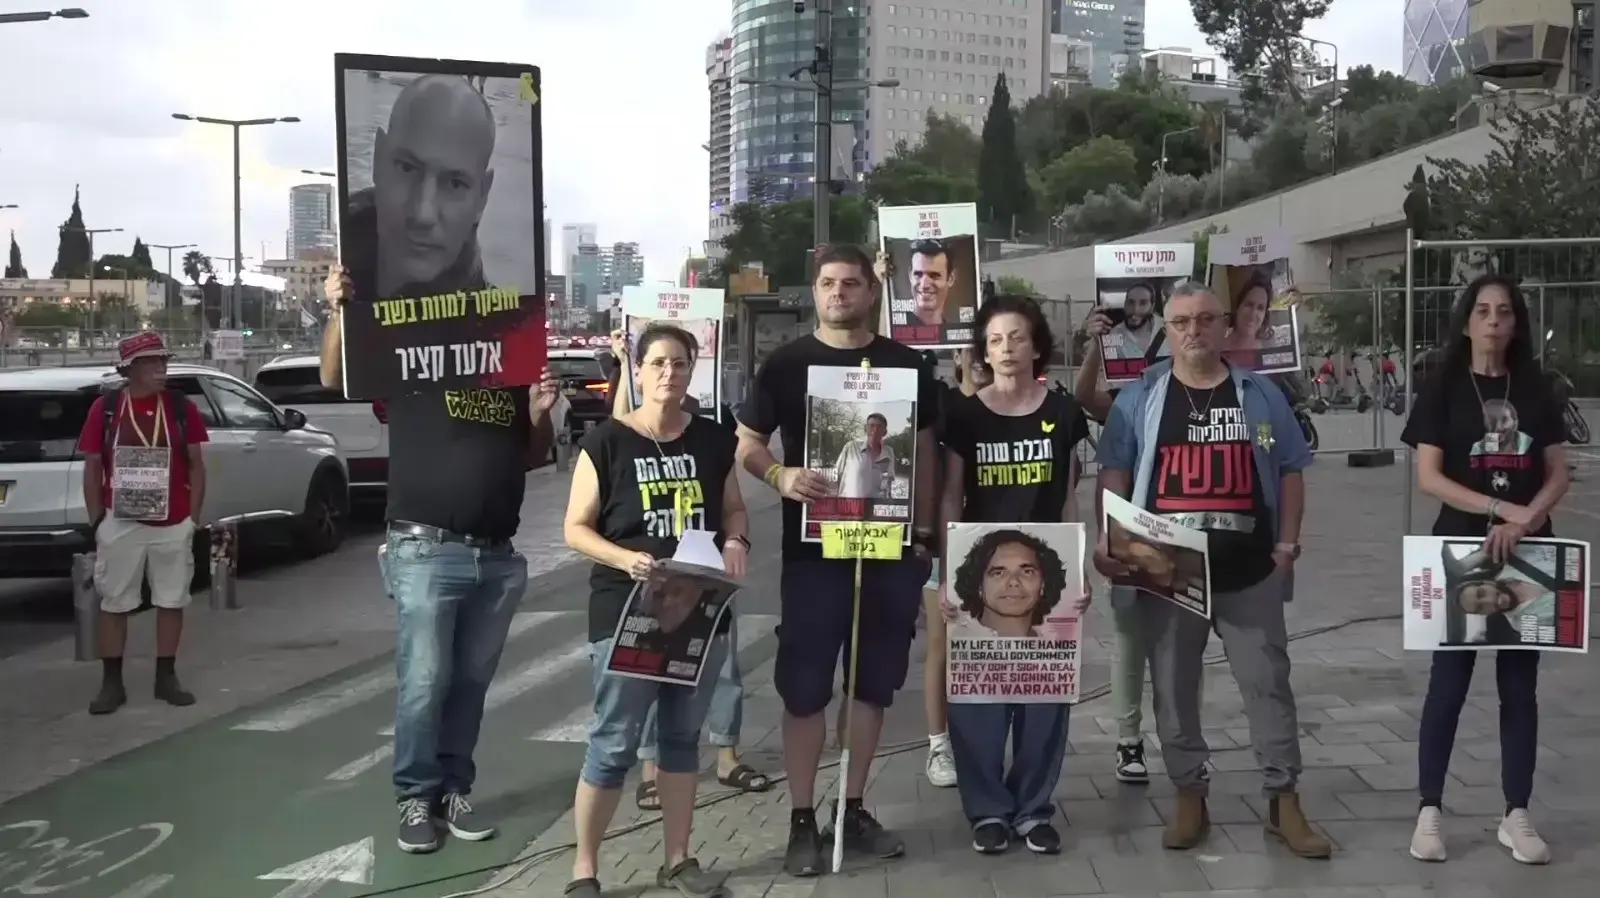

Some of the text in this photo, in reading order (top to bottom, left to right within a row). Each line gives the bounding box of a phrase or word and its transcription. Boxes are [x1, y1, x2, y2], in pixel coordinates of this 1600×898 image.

[1114, 250, 1176, 265] מתן עדיין חי
[372, 297, 418, 327] בשבי
[420, 290, 467, 321] למוות
[892, 299, 915, 312] BRING
[394, 340, 503, 382] אלעד קציר
[448, 402, 516, 426] WARS
[1210, 407, 1246, 425] חזירים
[1187, 424, 1224, 443] הביתה
[976, 438, 1053, 464] תכלה שנה
[633, 453, 697, 483] למה הם
[1158, 443, 1253, 495] עכשיו
[835, 528, 889, 540] אבא חטוף
[848, 542, 876, 553] בעזה
[624, 615, 651, 634] BRING
[1520, 614, 1538, 643] BRING
[1538, 625, 1556, 644] HIM
[951, 640, 967, 650] MY
[970, 640, 994, 650] LIFE
[1014, 640, 1036, 650] THE
[1038, 640, 1077, 650] HANDS
[970, 651, 1008, 661] ISRAELI
[1010, 651, 1077, 661] GOVERNMENT
[951, 662, 1076, 672] IF THEY DON'T SIGN A DEAL
[951, 673, 1076, 683] THEY ARE SIGNING MY
[951, 684, 1075, 696] DEATH WARRANT!
